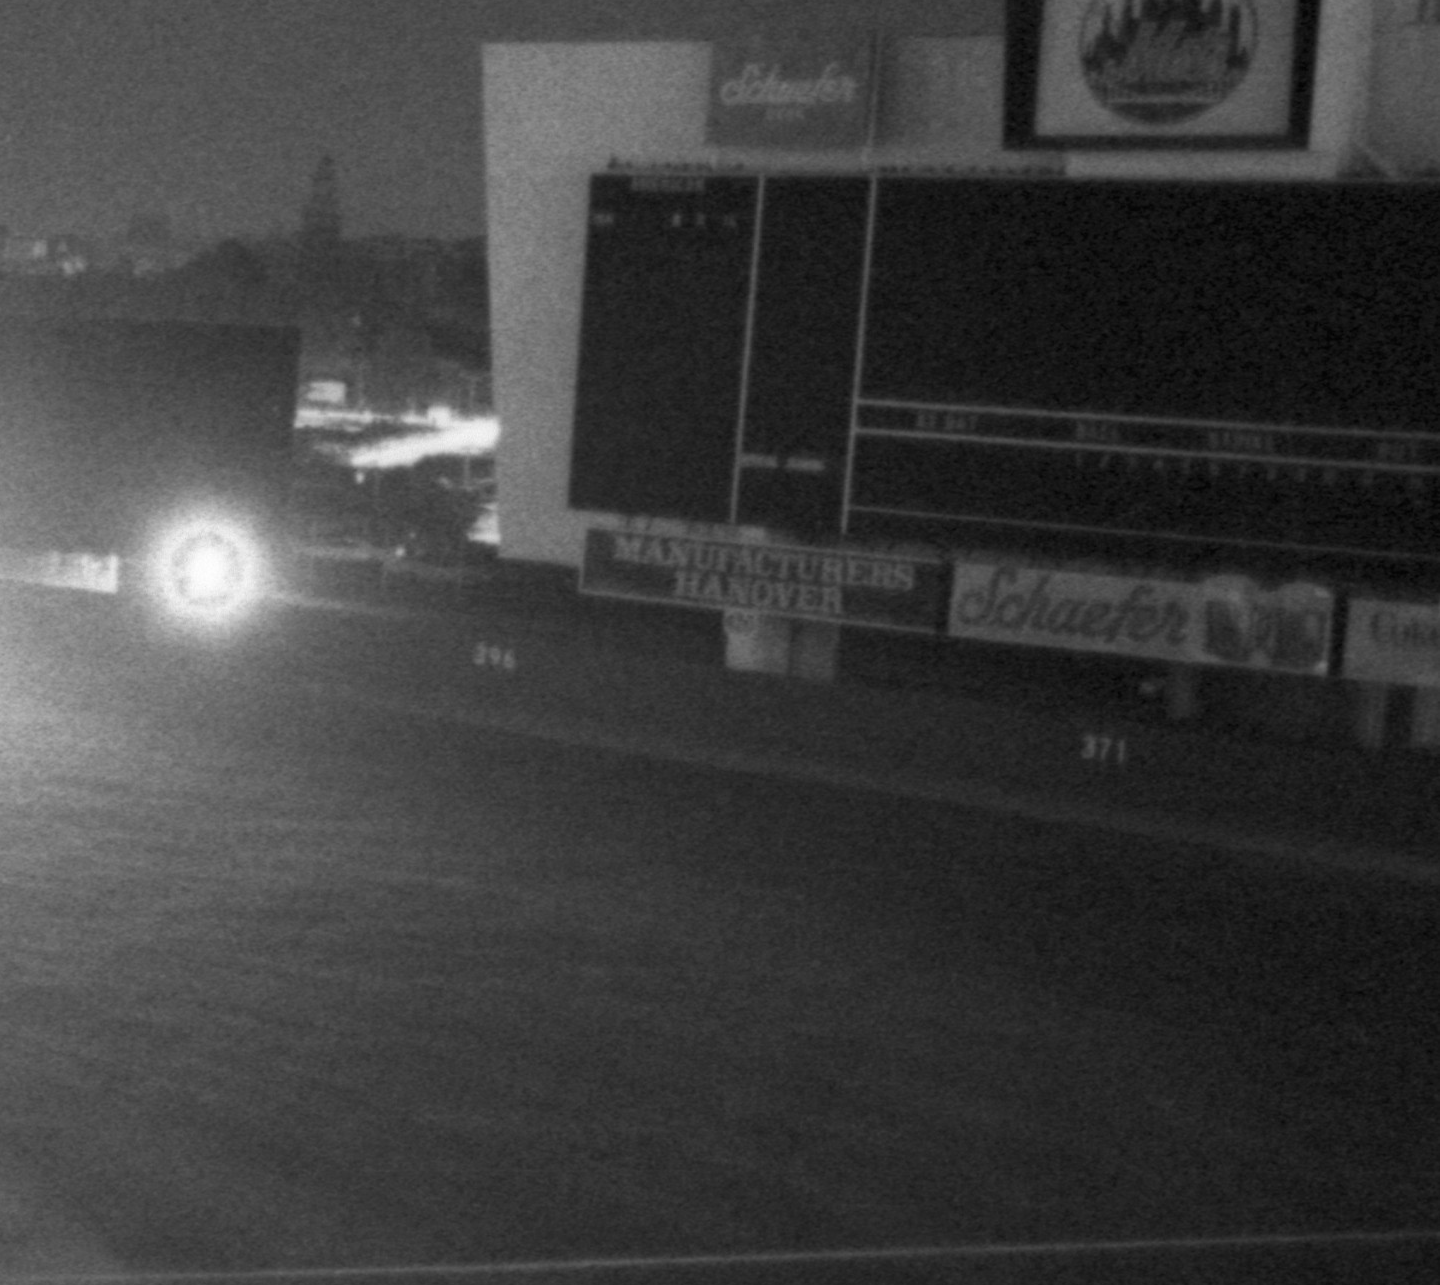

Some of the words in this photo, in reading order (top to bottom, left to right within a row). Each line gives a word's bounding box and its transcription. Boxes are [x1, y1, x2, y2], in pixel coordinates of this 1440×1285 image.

[720, 61, 857, 107] Schaefer
[613, 535, 915, 591] MANUFACTURERS
[675, 570, 844, 614] HANOVER
[958, 563, 1190, 645] Schaefer
[1080, 732, 1127, 765] 371
